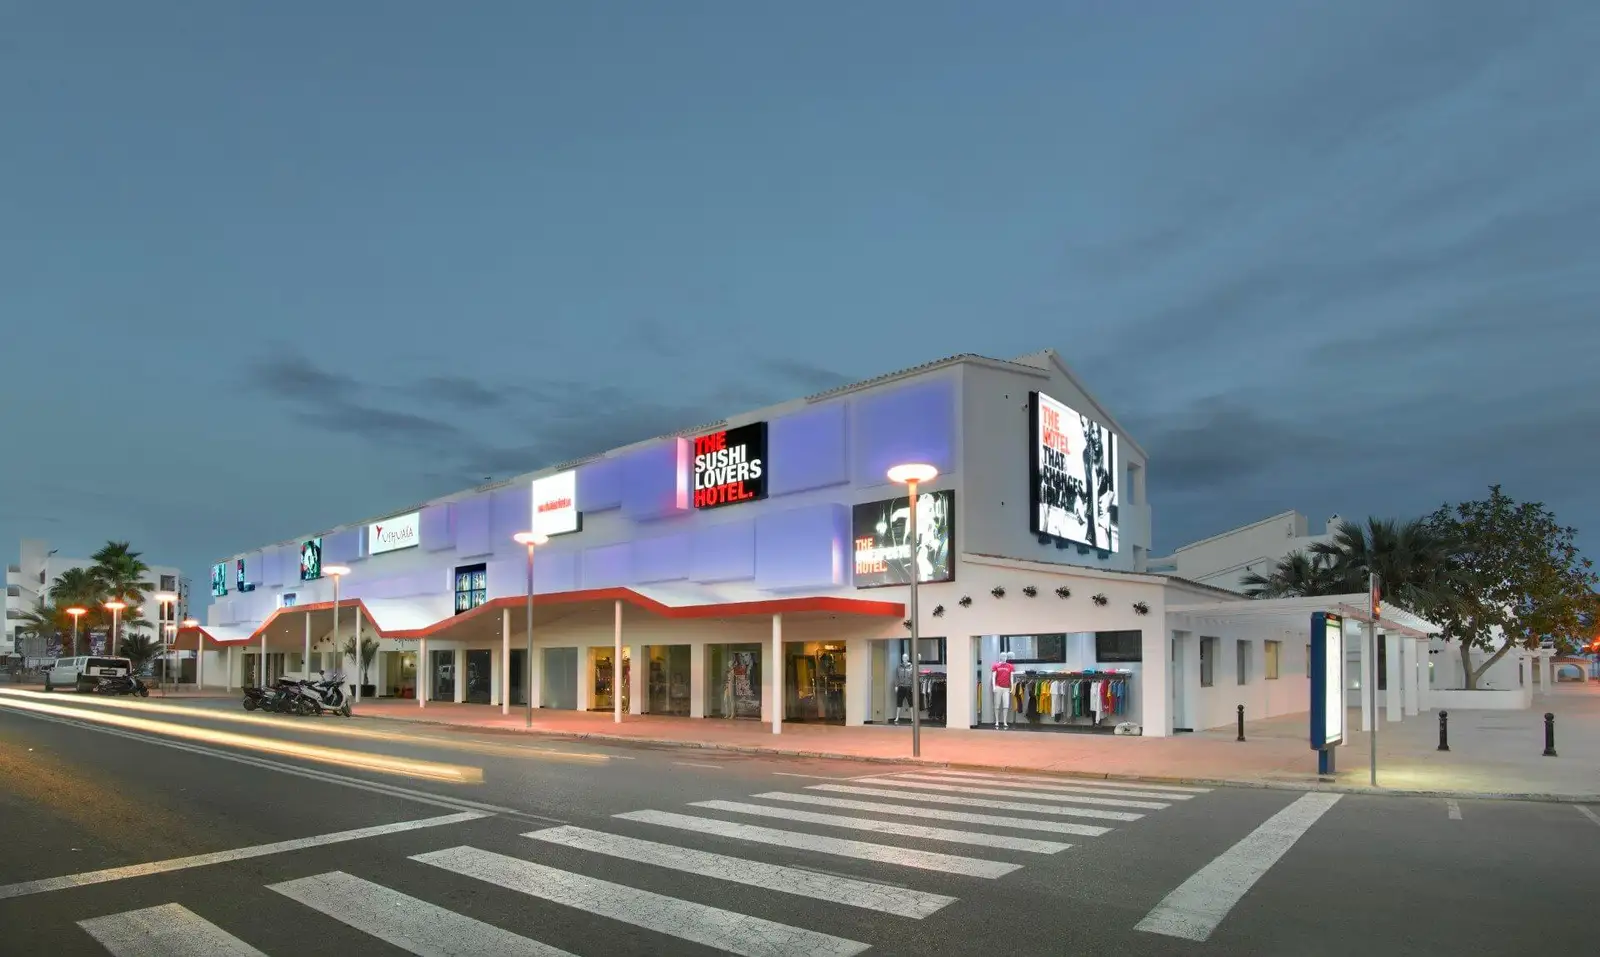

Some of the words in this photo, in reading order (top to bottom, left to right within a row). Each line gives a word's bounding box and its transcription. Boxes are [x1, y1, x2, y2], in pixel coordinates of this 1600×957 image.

[1042, 404, 1059, 431] THE
[695, 431, 727, 455] THE
[695, 444, 746, 473] SUSHI
[1043, 444, 1065, 472] THAT
[695, 459, 762, 490] LOVERS
[694, 481, 753, 508] HOTEL.
[855, 538, 874, 552] THE
